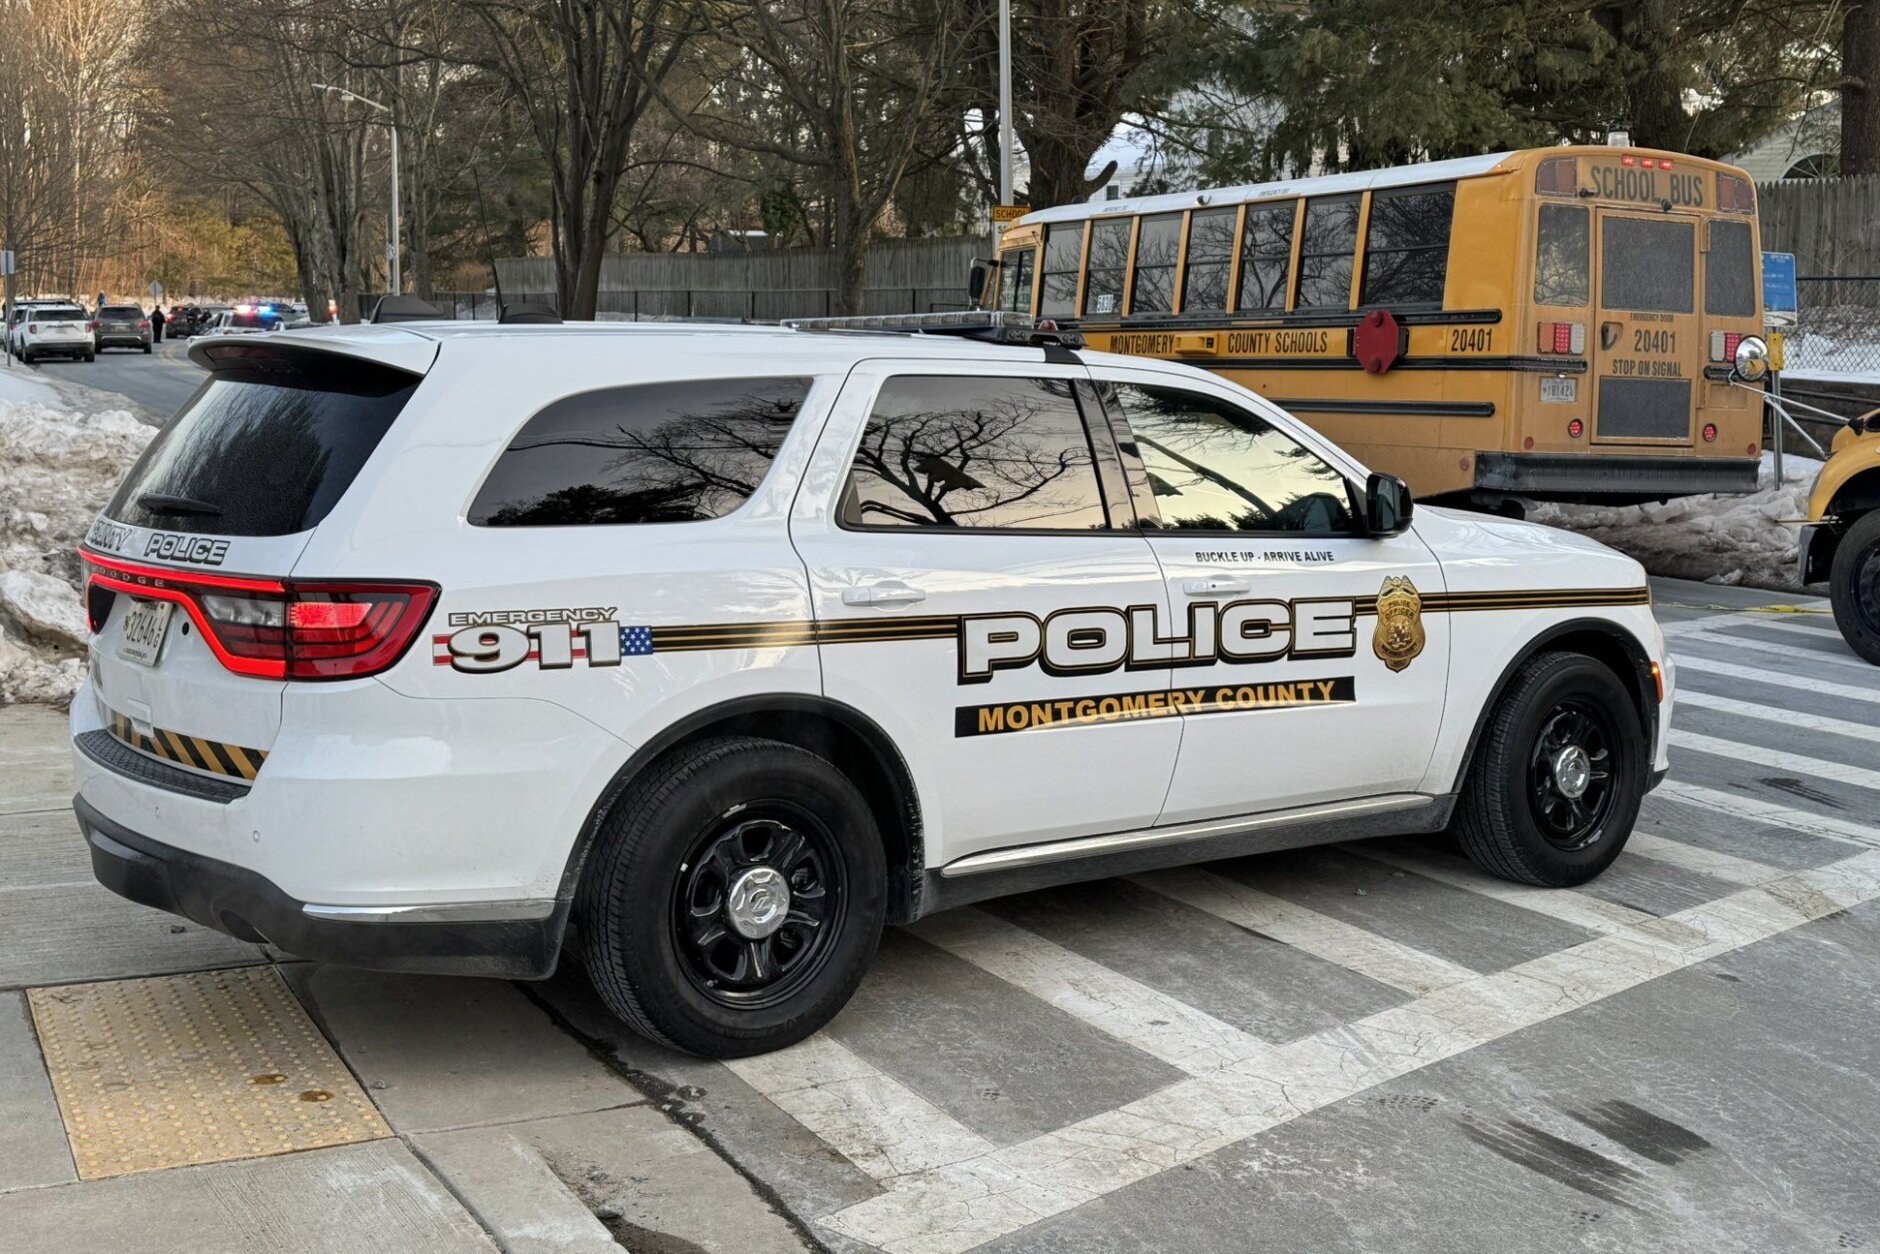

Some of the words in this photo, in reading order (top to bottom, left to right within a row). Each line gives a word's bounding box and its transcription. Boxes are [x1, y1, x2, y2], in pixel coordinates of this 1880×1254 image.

[1590, 165, 1661, 203] SCHOOL
[1669, 173, 1703, 207] BUS
[1110, 334, 1176, 355] MONTGOMERY
[1227, 332, 1271, 353] COUNTY
[1274, 331, 1328, 353] SCHOOLS
[1451, 328, 1492, 352] 20401
[1634, 329, 1676, 354] 20401
[1612, 359, 1636, 375] STOP
[1638, 360, 1650, 376] ON
[1652, 361, 1682, 377] SIGNAL
[144, 533, 231, 566] POLICE
[1195, 551, 1239, 562] BUCKLE
[1240, 551, 1254, 562] UP
[1264, 551, 1301, 562] ARRIVE
[1304, 551, 1334, 562] ALIVE
[100, 567, 164, 587] DODGE
[448, 607, 618, 627] EMERGENCY
[1384, 607, 1415, 620] OFFICER
[447, 620, 622, 674] 911
[957, 597, 1357, 685] POLICE
[978, 689, 1206, 732] MONTGOMERY
[1215, 680, 1335, 715] COUNTY
